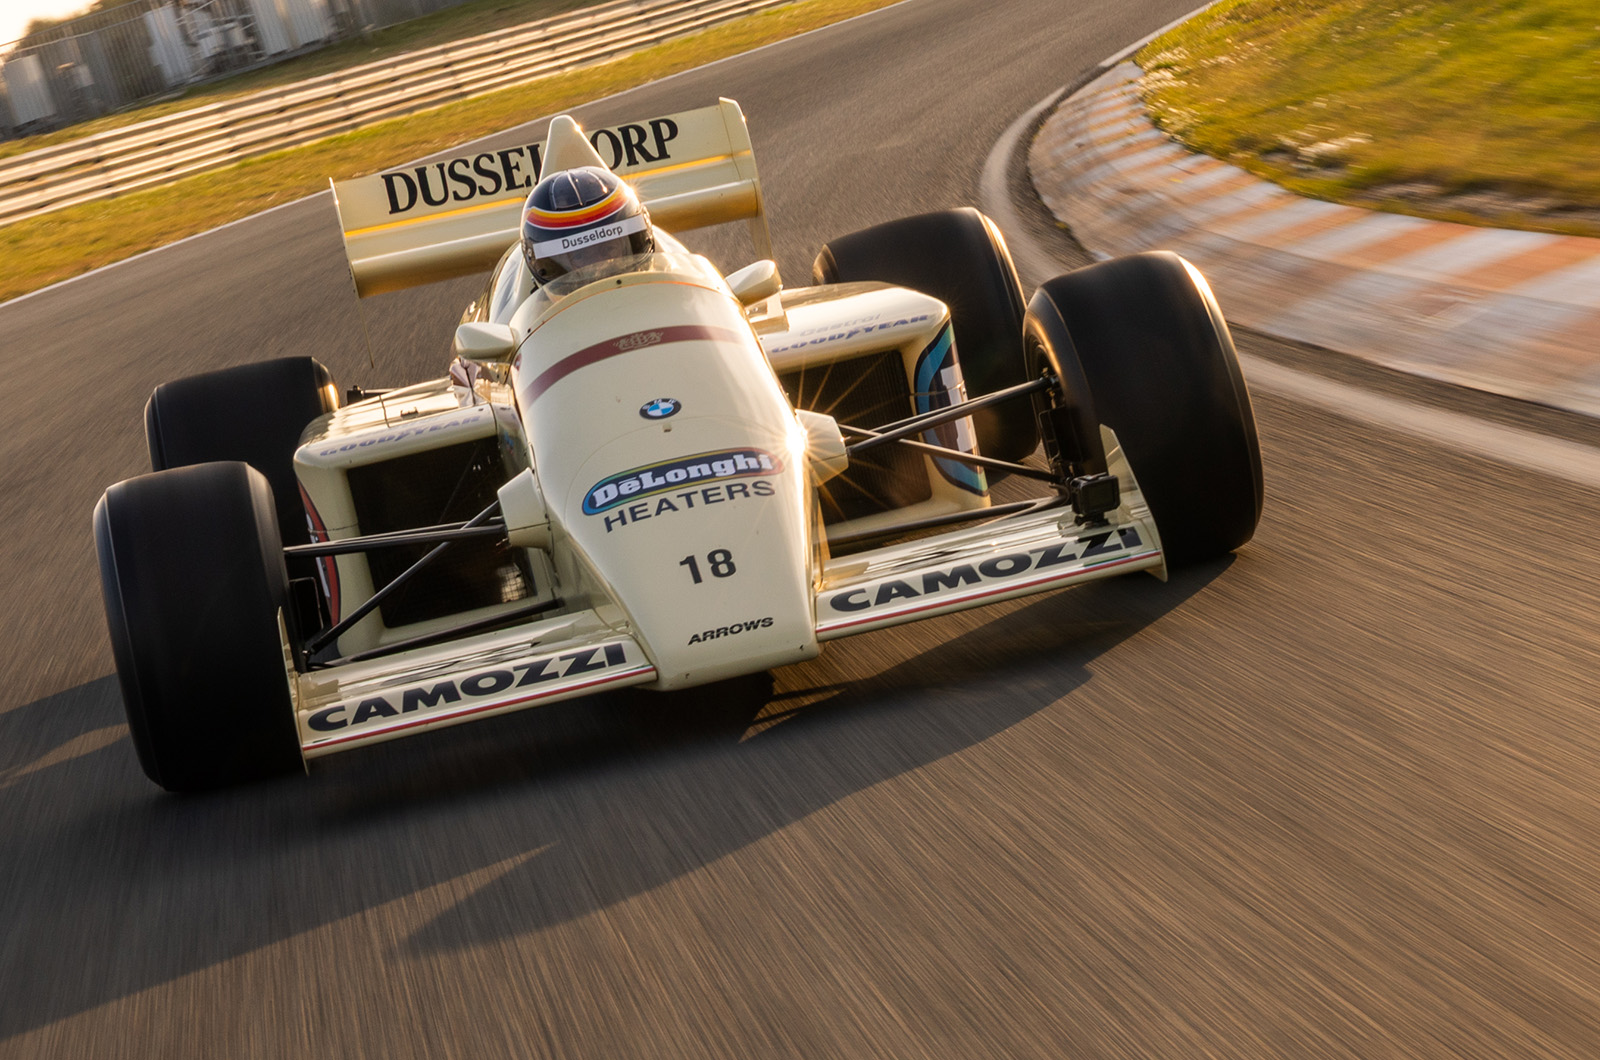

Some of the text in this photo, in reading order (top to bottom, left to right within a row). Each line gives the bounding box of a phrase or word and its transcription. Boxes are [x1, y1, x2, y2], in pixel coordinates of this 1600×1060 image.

[381, 118, 679, 215] DUSSELORP
[561, 225, 623, 250] Dusseldorp
[603, 480, 776, 534] HEATERS
[679, 548, 737, 585] 18
[829, 526, 1143, 613] CAMOZZI
[687, 617, 775, 646] ARROWS
[307, 642, 627, 732] CAMOZZI
